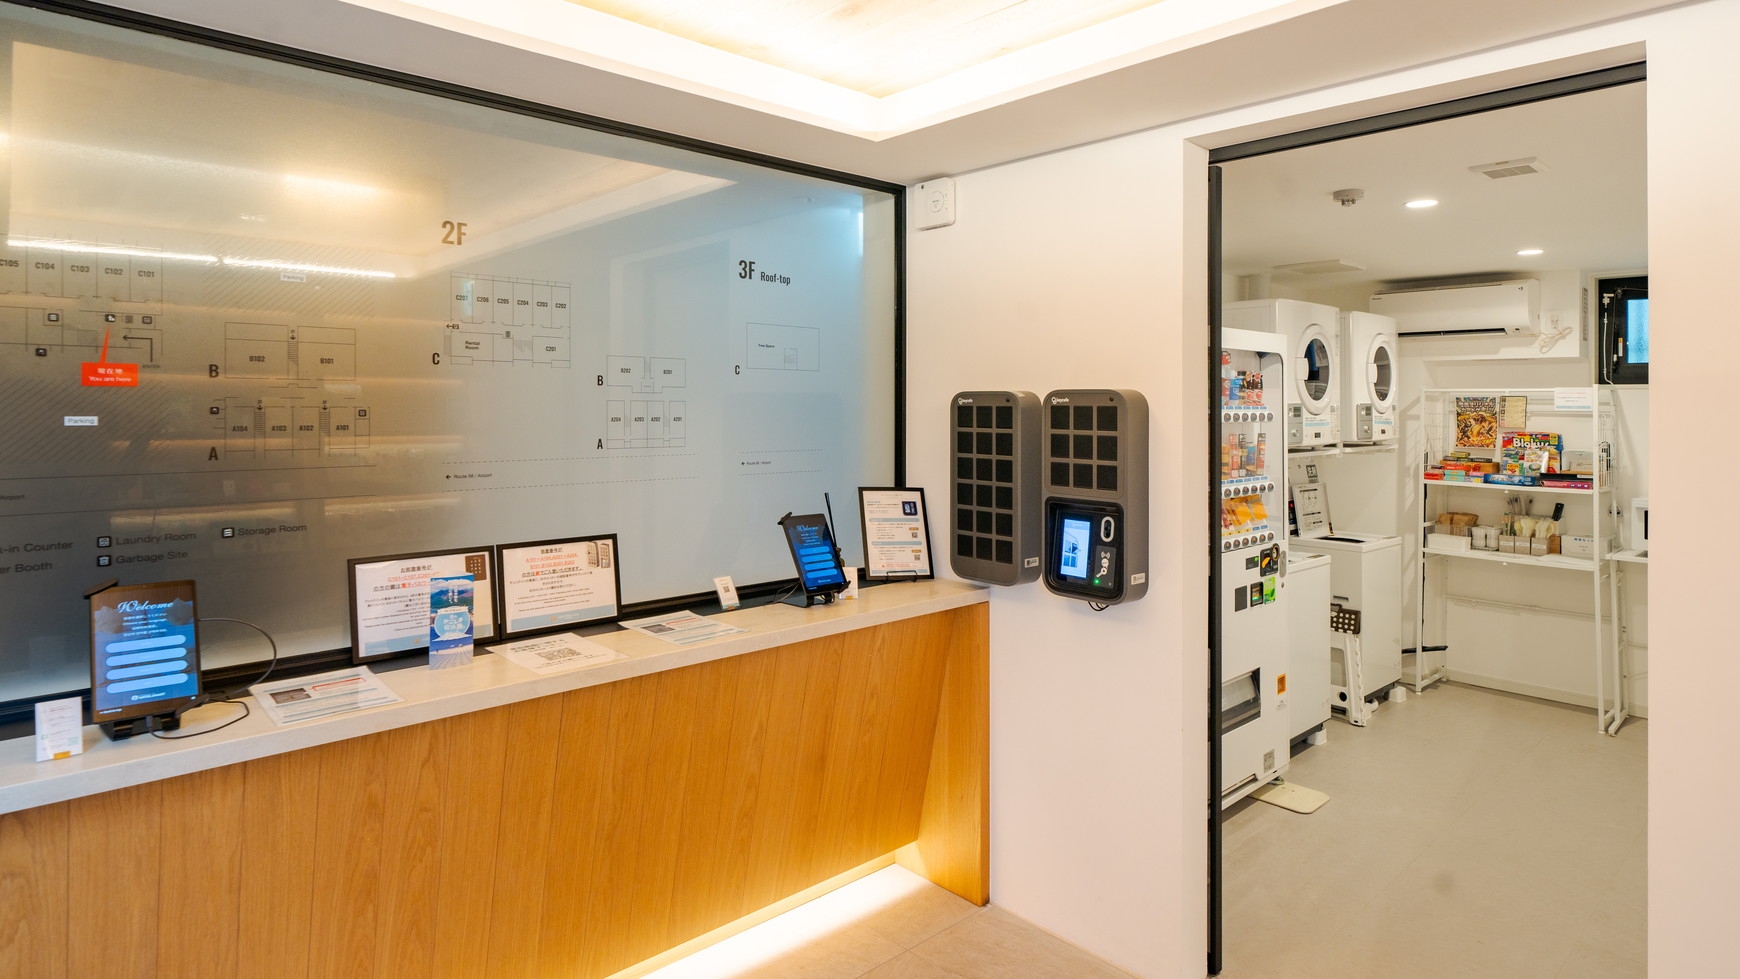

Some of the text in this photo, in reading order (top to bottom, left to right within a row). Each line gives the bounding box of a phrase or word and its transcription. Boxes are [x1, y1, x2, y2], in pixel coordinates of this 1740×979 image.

[441, 220, 468, 246] 2F
[0, 259, 19, 268] C105
[35, 262, 55, 270] C104
[70, 264, 90, 273] C103
[104, 268, 123, 276] C102
[138, 270, 155, 278] C101
[738, 260, 790, 286] 3F Roof-top
[282, 274, 304, 282] Parking
[432, 352, 440, 365] C
[208, 364, 219, 378] B
[734, 365, 740, 375] C
[597, 375, 604, 386] B
[597, 438, 603, 450] A
[1513, 437, 1549, 448] Blokus
[208, 447, 219, 461] A
[238, 524, 307, 536] Storage Room
[116, 532, 197, 546] Laundry Room
[24, 542, 74, 552] Counter
[116, 551, 188, 565] Garbage Site
[15, 562, 53, 573] Booth
[117, 600, 174, 614] Welcome
